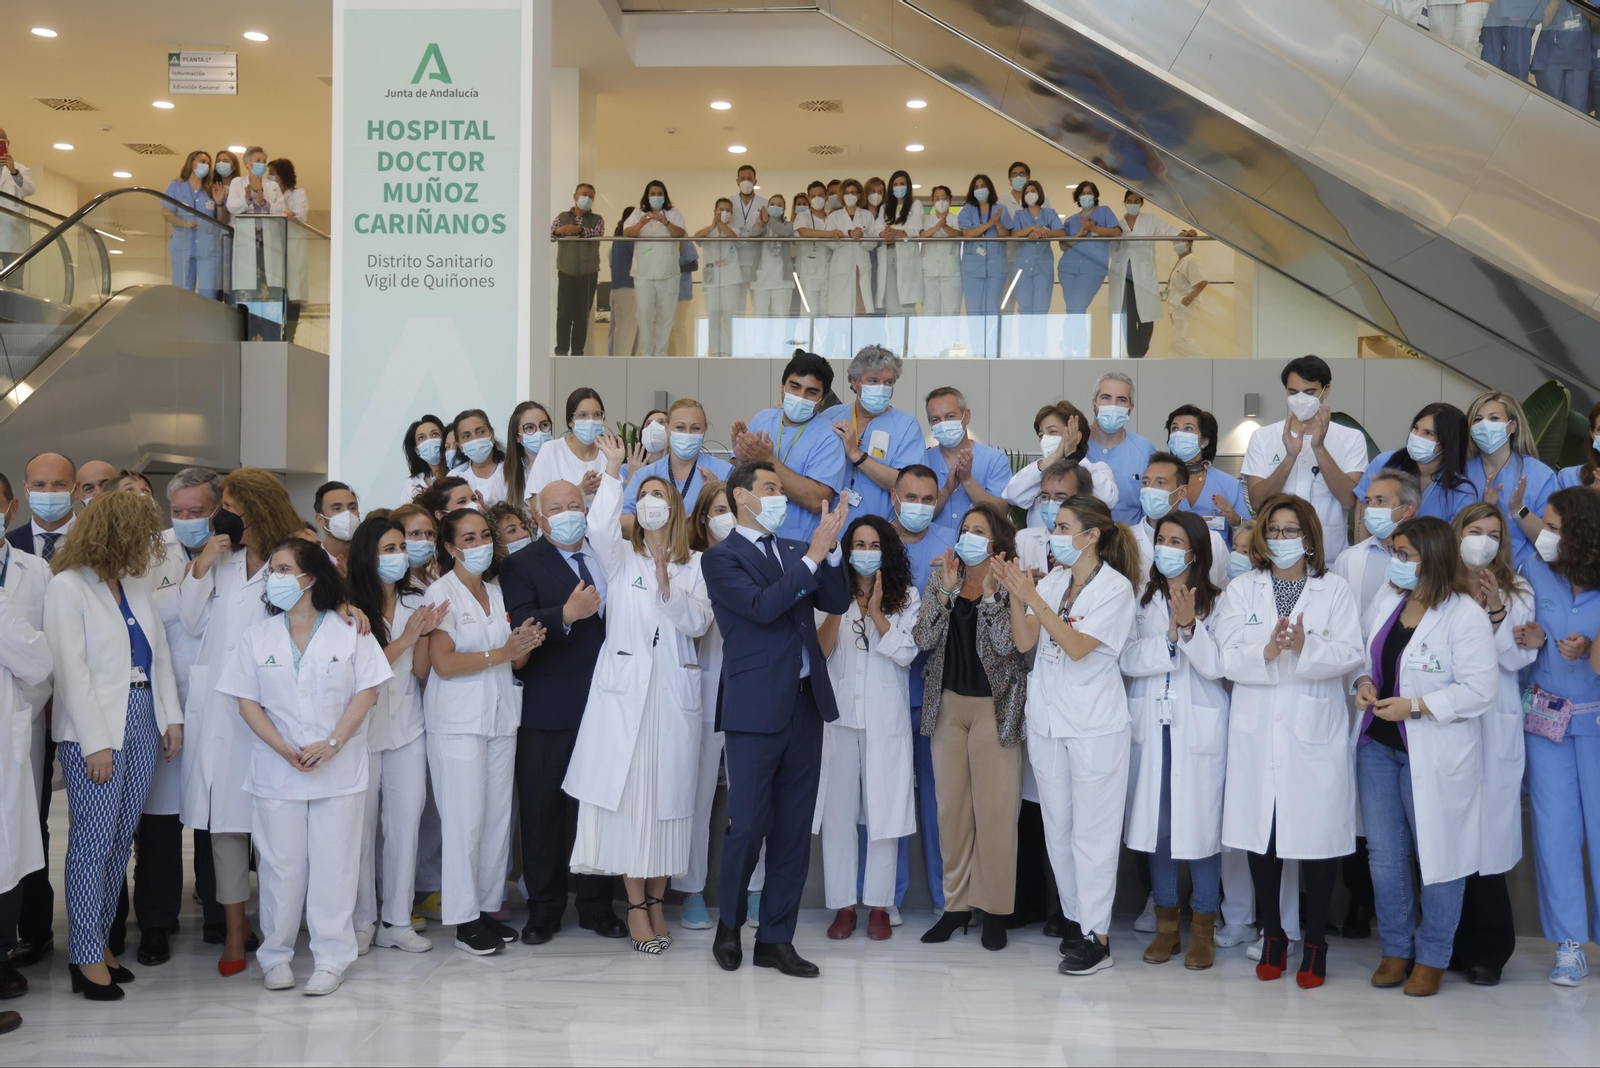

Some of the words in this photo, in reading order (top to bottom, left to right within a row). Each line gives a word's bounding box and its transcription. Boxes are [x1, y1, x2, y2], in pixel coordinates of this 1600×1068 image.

[385, 89, 413, 98] Junta
[416, 88, 428, 98] de
[430, 87, 479, 98] Andalucía
[367, 119, 496, 141] HOSPITAL
[377, 151, 485, 172] DOCTOR
[383, 177, 479, 203] MUÑOZ
[354, 208, 507, 234] CARIÑANOS
[367, 254, 422, 268] Distrito
[426, 254, 494, 268] Sanitario
[365, 273, 397, 291] Vigil
[401, 273, 420, 288] de
[424, 273, 495, 291] Quiñones
